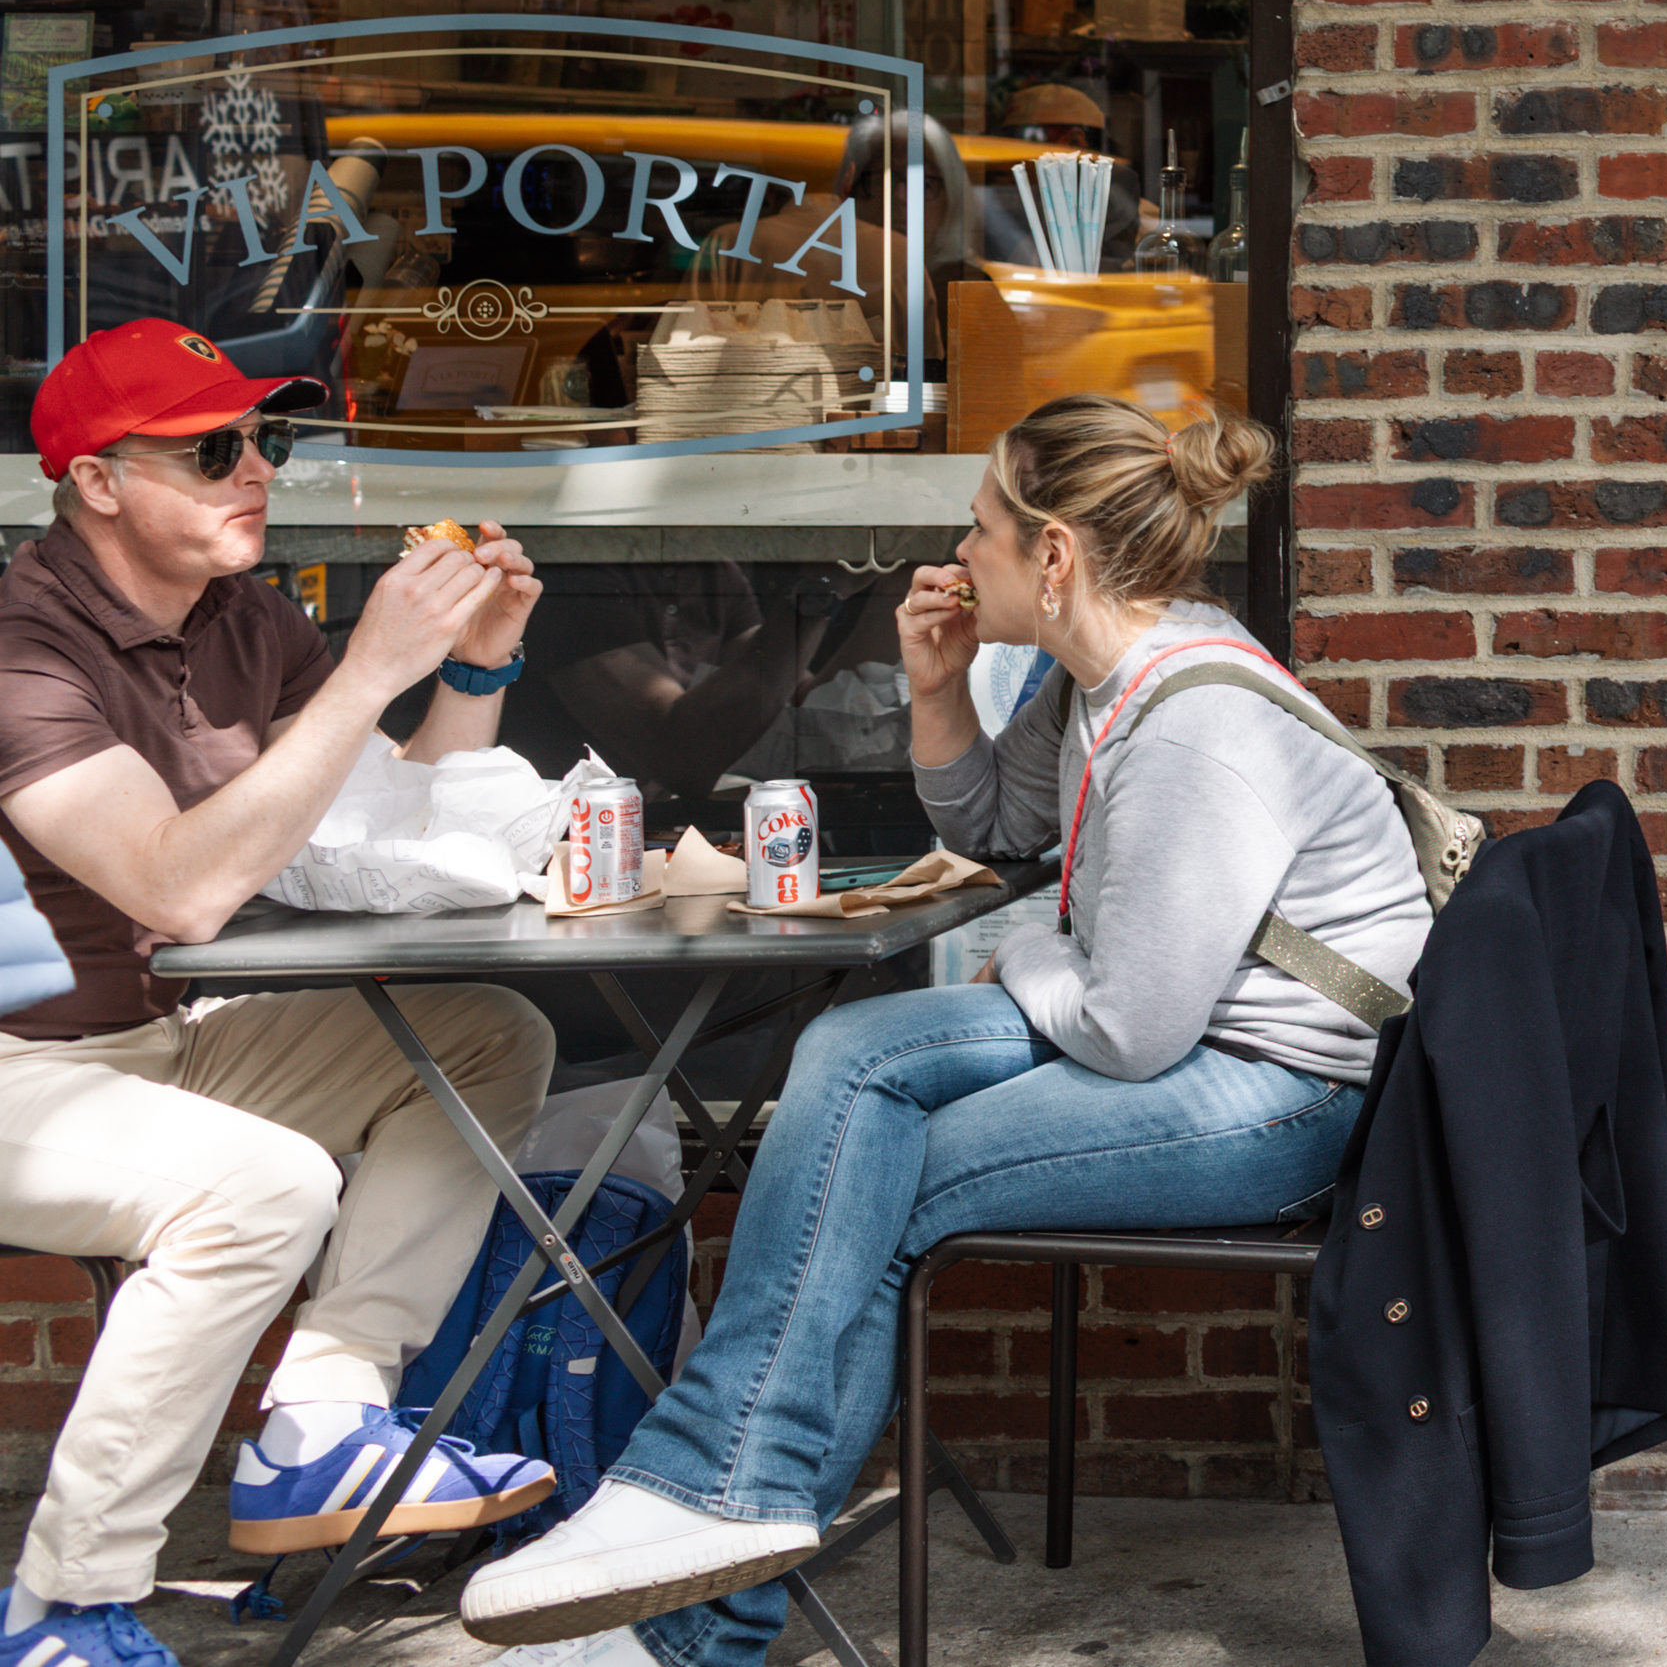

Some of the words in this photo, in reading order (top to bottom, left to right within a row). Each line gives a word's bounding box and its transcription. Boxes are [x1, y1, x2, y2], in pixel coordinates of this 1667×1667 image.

[106, 159, 379, 286] VIA
[409, 142, 867, 298] PORTA
[757, 812, 809, 841] Coke
[567, 1261, 581, 1279] emu
